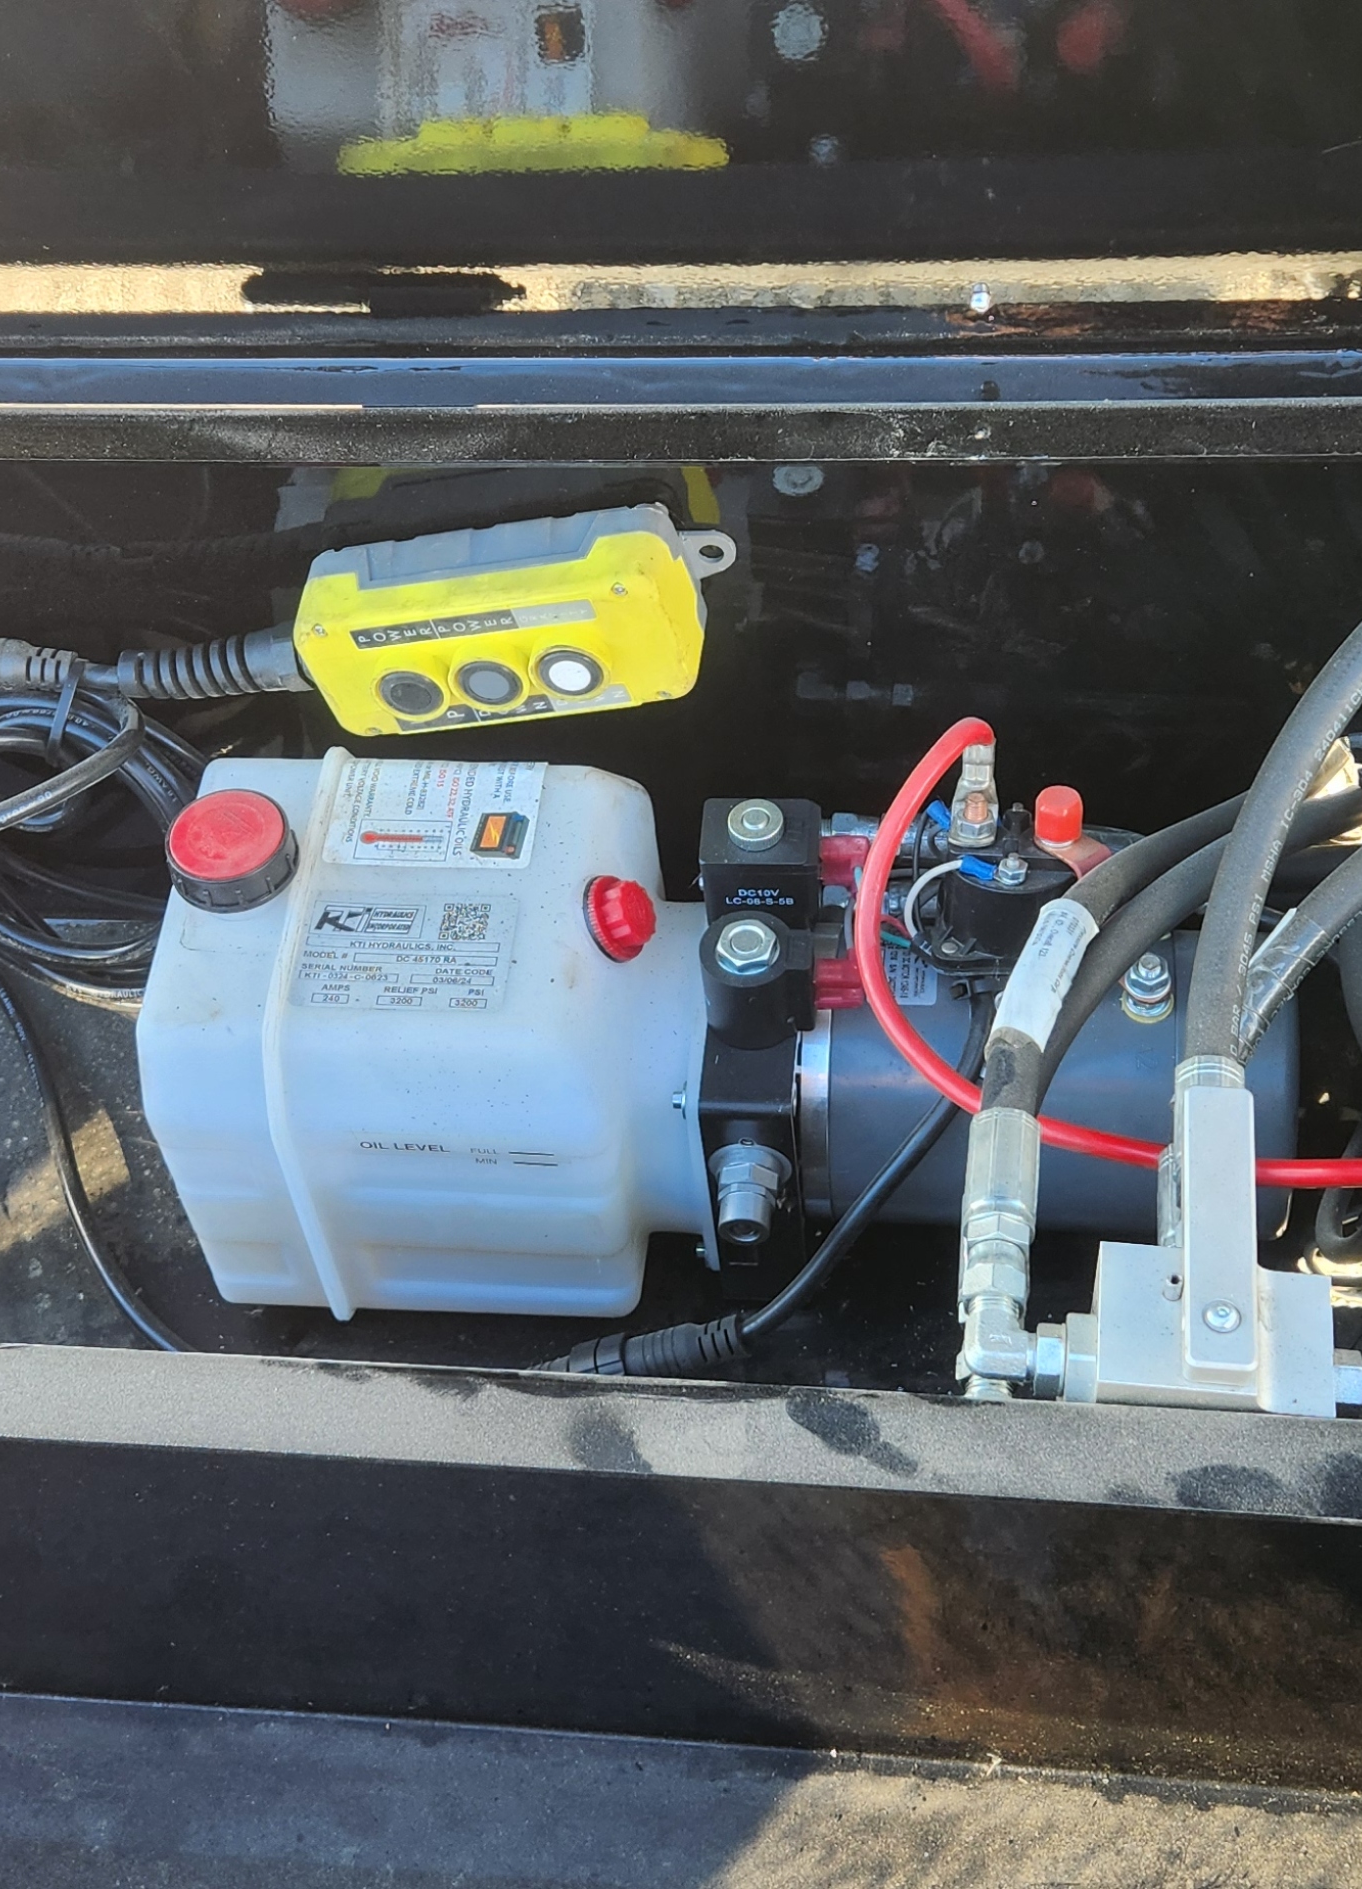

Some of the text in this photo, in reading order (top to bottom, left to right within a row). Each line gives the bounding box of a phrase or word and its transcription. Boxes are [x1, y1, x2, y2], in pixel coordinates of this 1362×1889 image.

[437, 615, 514, 635] POWER
[357, 625, 433, 644] POWER
[451, 788, 474, 857] HYDRAULIC OILS
[1260, 838, 1283, 883] MSHA
[737, 888, 780, 898] DC10V
[349, 941, 366, 949] KTI
[303, 951, 340, 960] MODEL
[395, 955, 410, 963] DC
[411, 956, 441, 964] 45170
[301, 963, 383, 973] SERIAL NUMBER
[435, 968, 463, 976] DATE
[321, 983, 351, 992] AMPS
[383, 985, 439, 996] RELIEF PSI
[467, 988, 485, 996] PSI
[390, 996, 413, 1006] 3200
[454, 998, 479, 1008] 3200
[359, 1141, 451, 1154] OIL LEVEL
[469, 1147, 499, 1156] FULL
[474, 1157, 498, 1166] MIN
